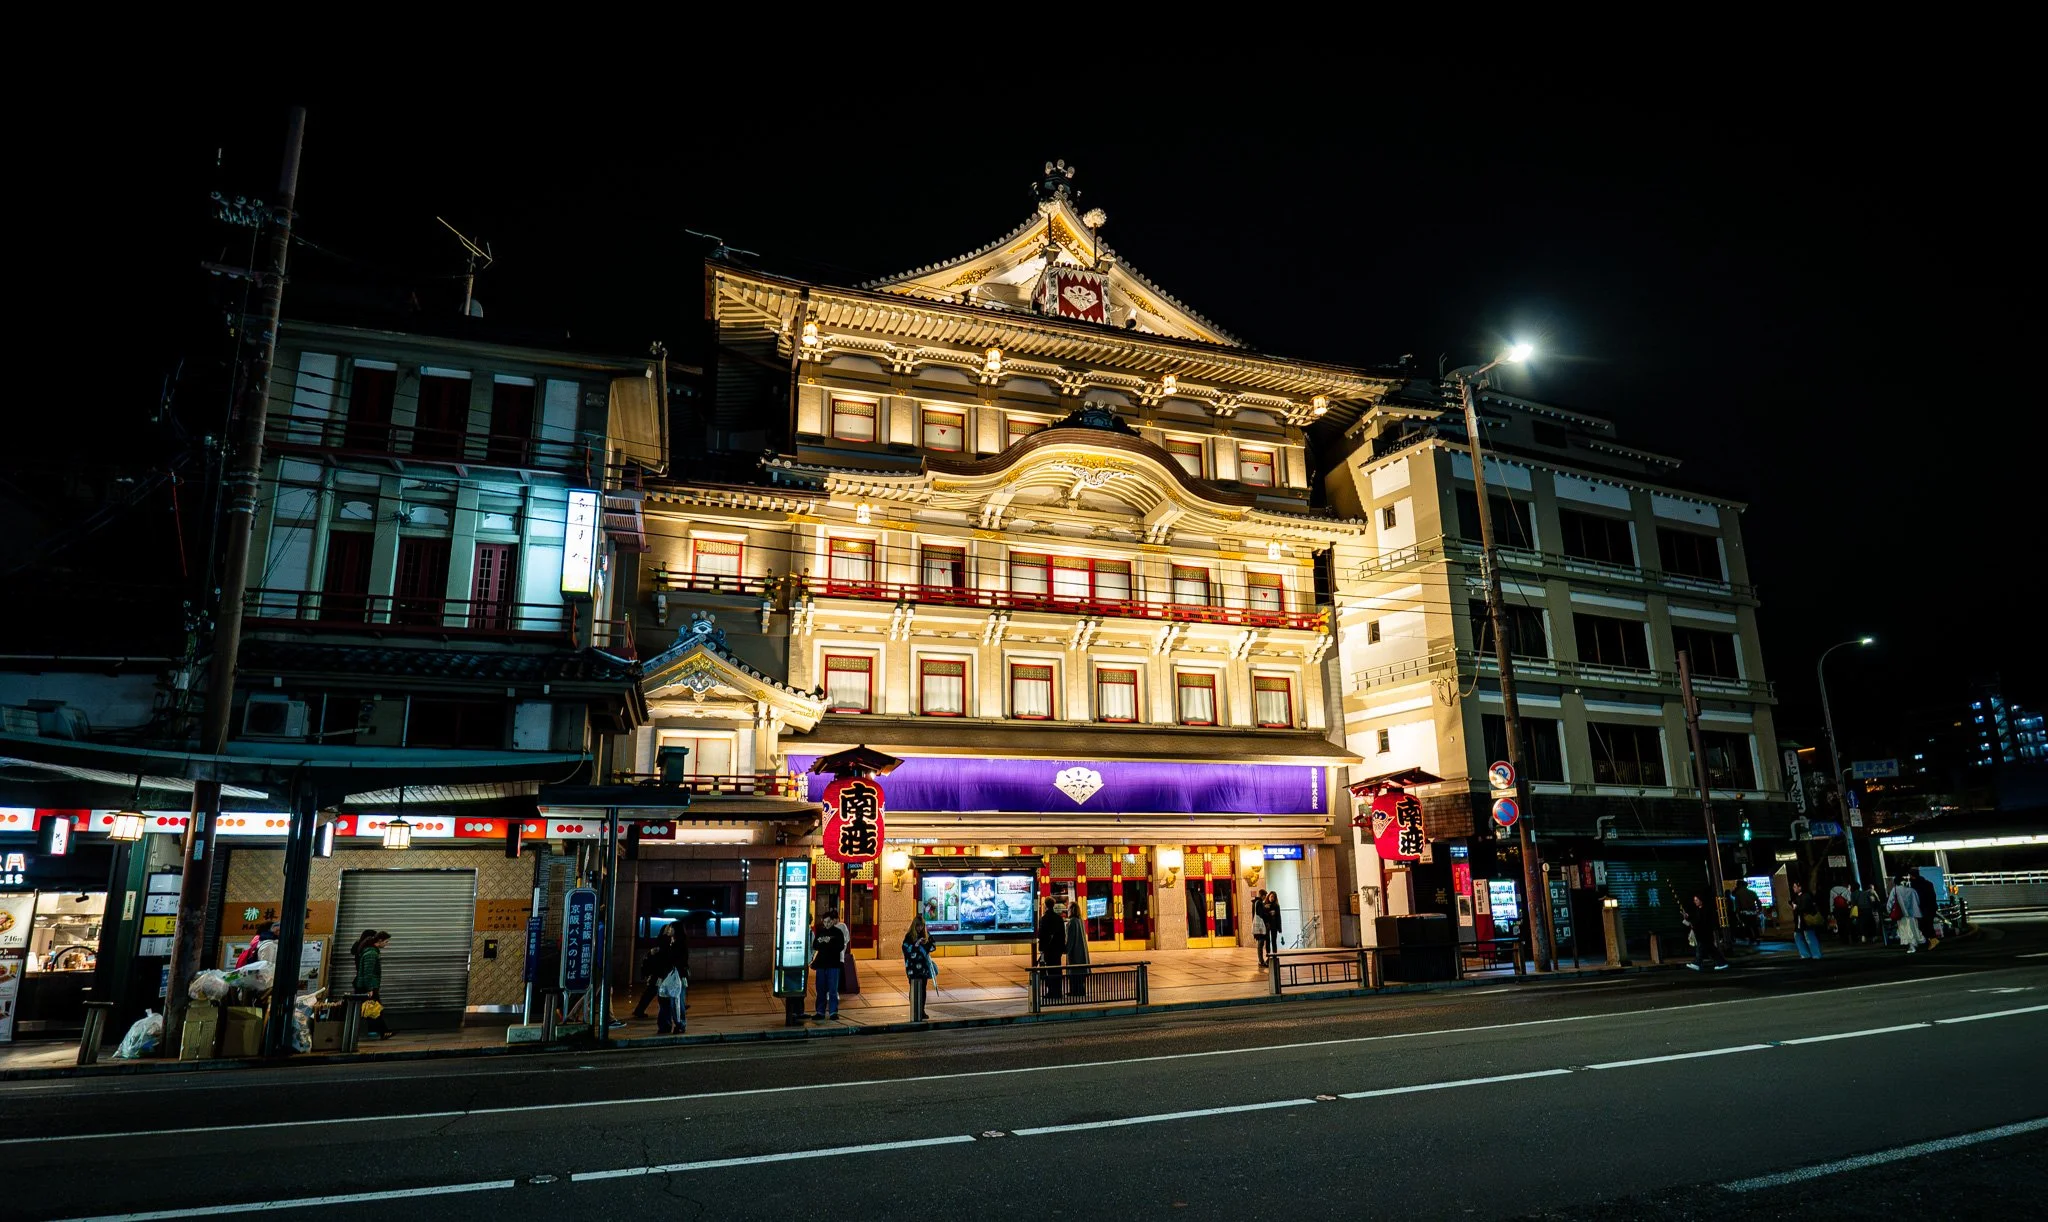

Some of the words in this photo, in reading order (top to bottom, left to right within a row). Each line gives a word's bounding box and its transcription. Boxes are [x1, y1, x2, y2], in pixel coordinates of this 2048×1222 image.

[0, 853, 26, 872] A
[567, 904, 580, 979] 京阪バスのりば
